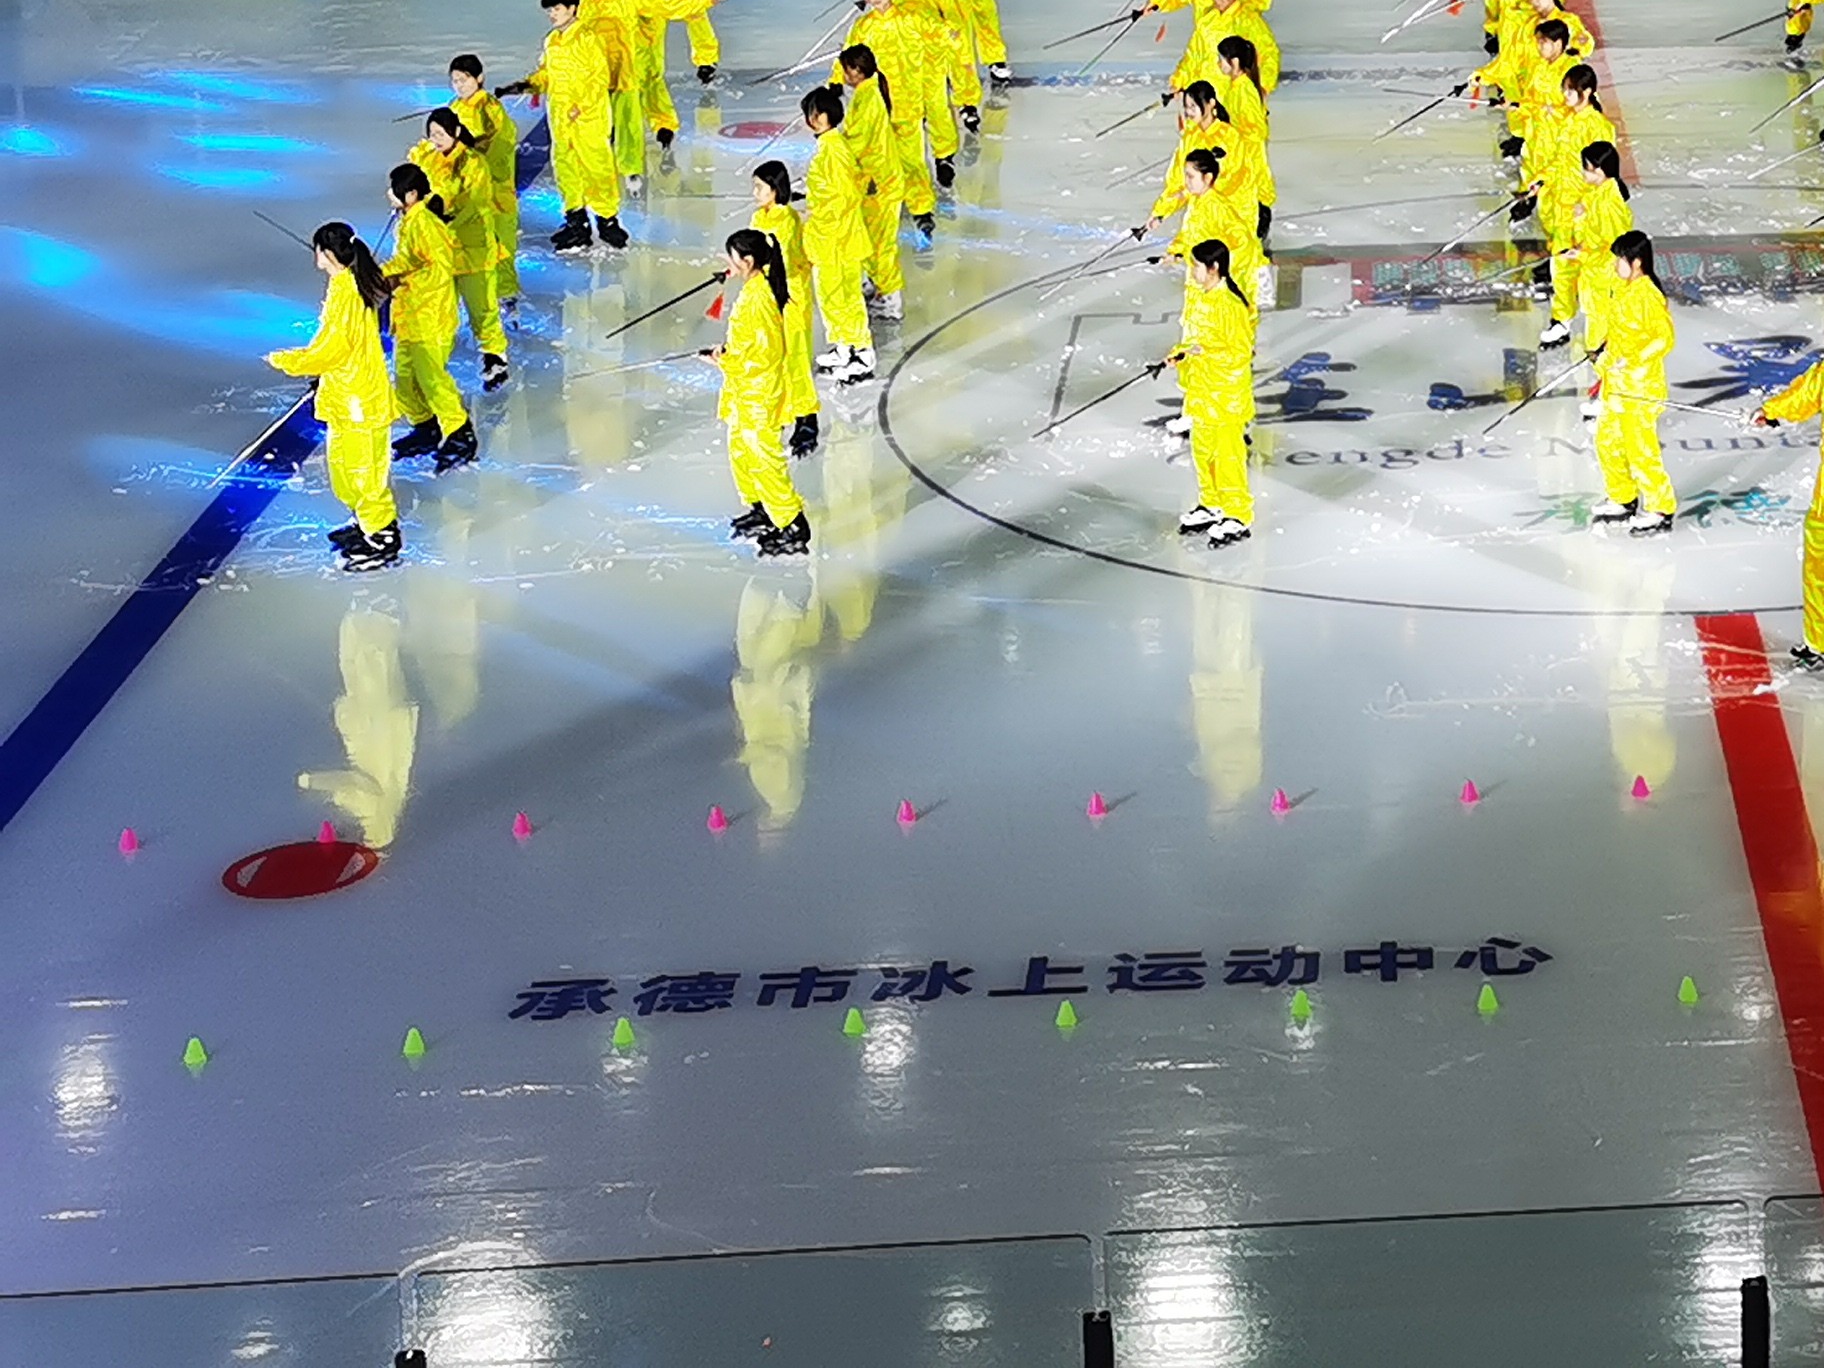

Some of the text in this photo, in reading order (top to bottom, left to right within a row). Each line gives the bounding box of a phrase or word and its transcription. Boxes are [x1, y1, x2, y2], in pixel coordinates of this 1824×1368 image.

[1164, 428, 1512, 470] Cengde
[508, 936, 1554, 1021] 承德市冰上运动中心
